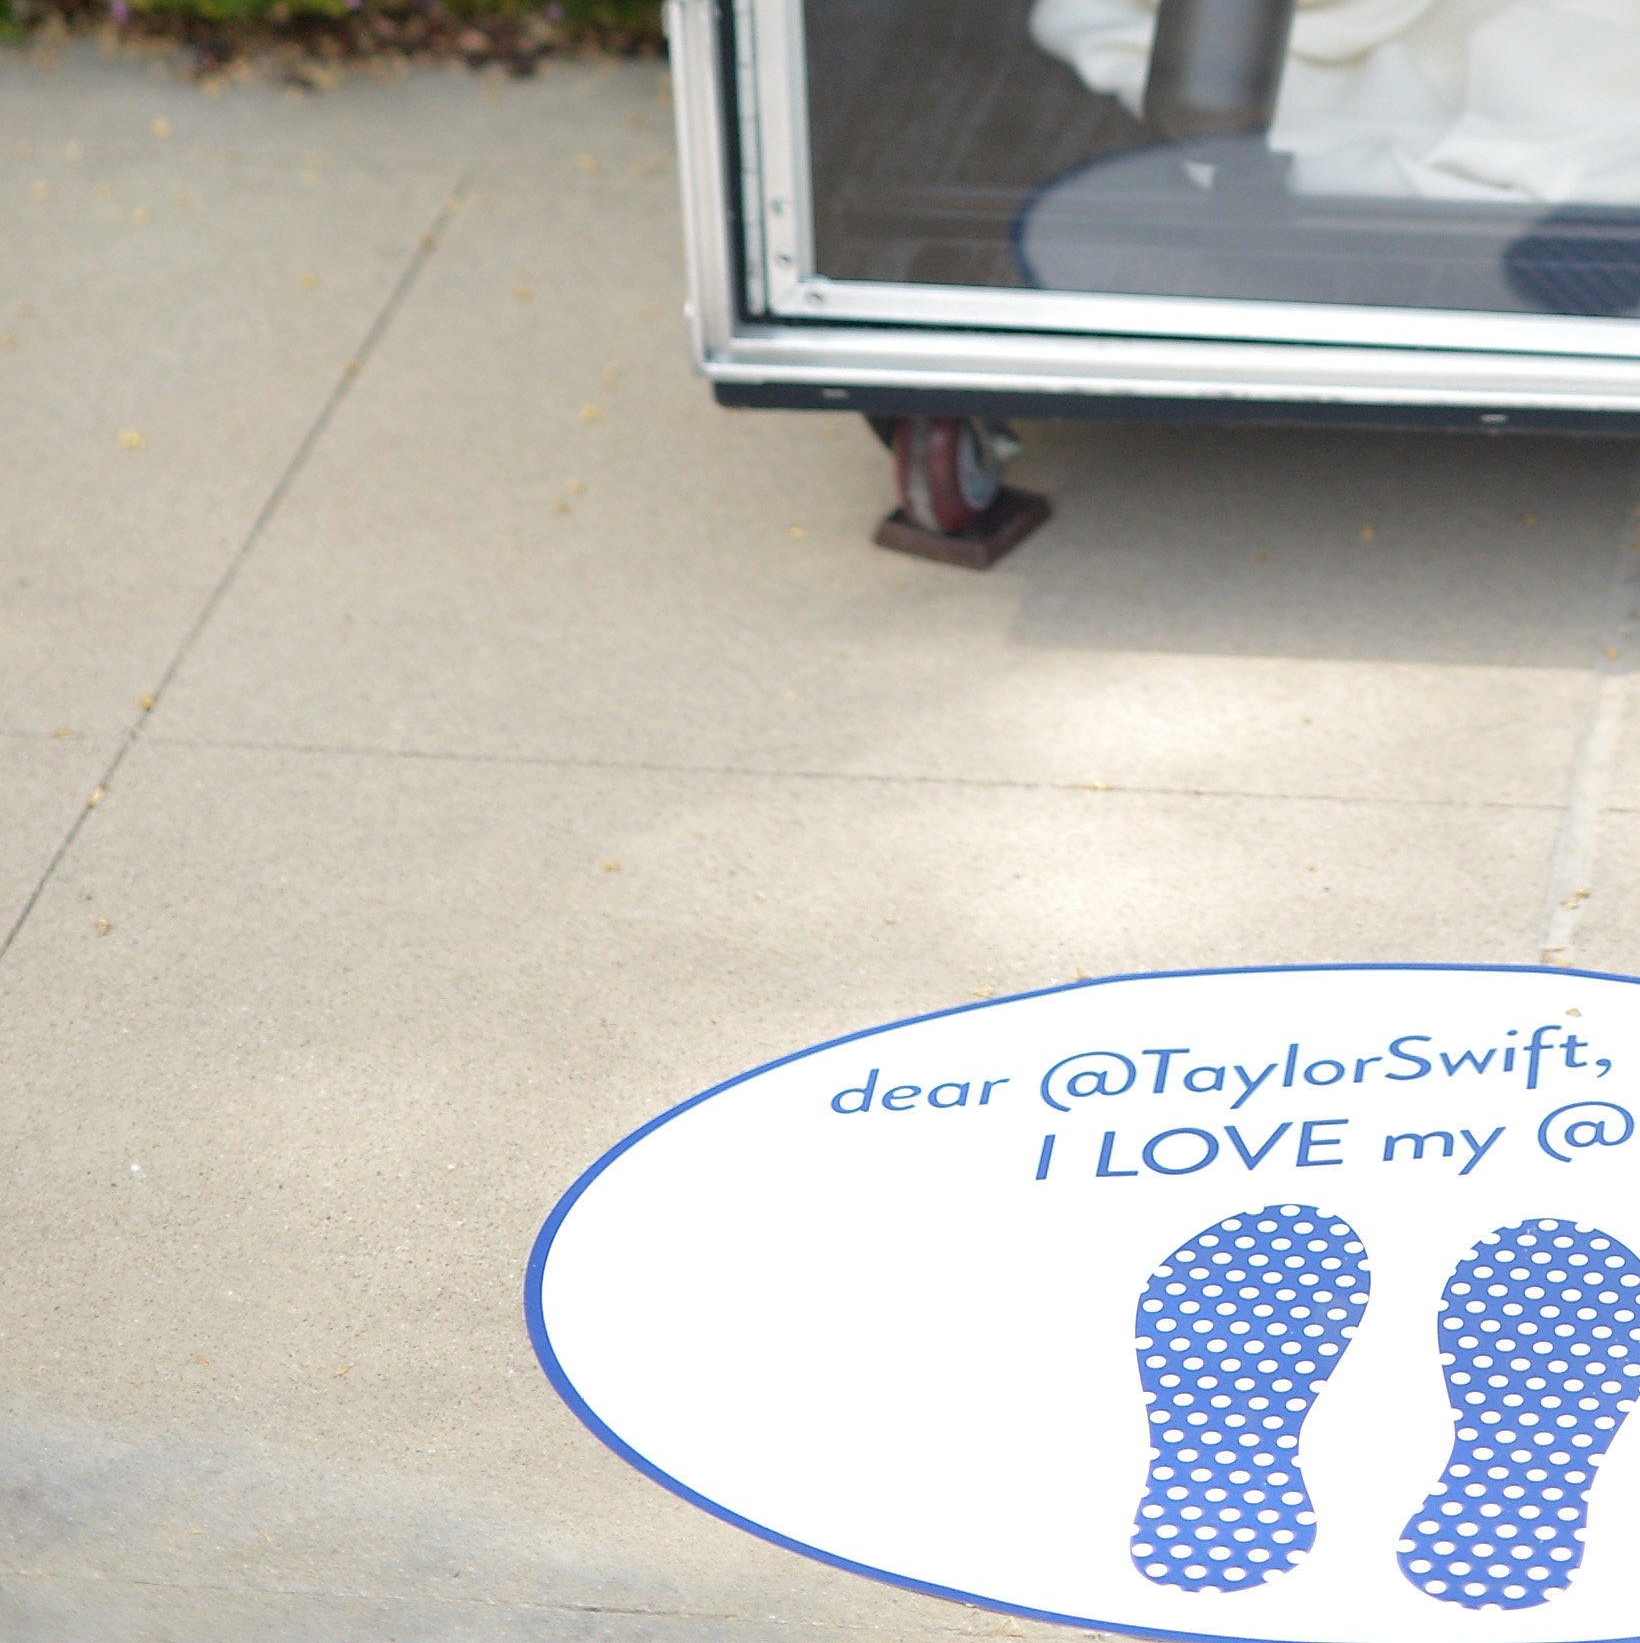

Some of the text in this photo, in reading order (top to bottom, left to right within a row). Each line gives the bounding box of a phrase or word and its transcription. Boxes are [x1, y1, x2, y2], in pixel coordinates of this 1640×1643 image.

[831, 1024, 1612, 1114] dear @TaylorSwift,
[1035, 1133, 1056, 1180] I
[1095, 1119, 1349, 1177] LOVE
[1382, 1126, 1506, 1175] my
